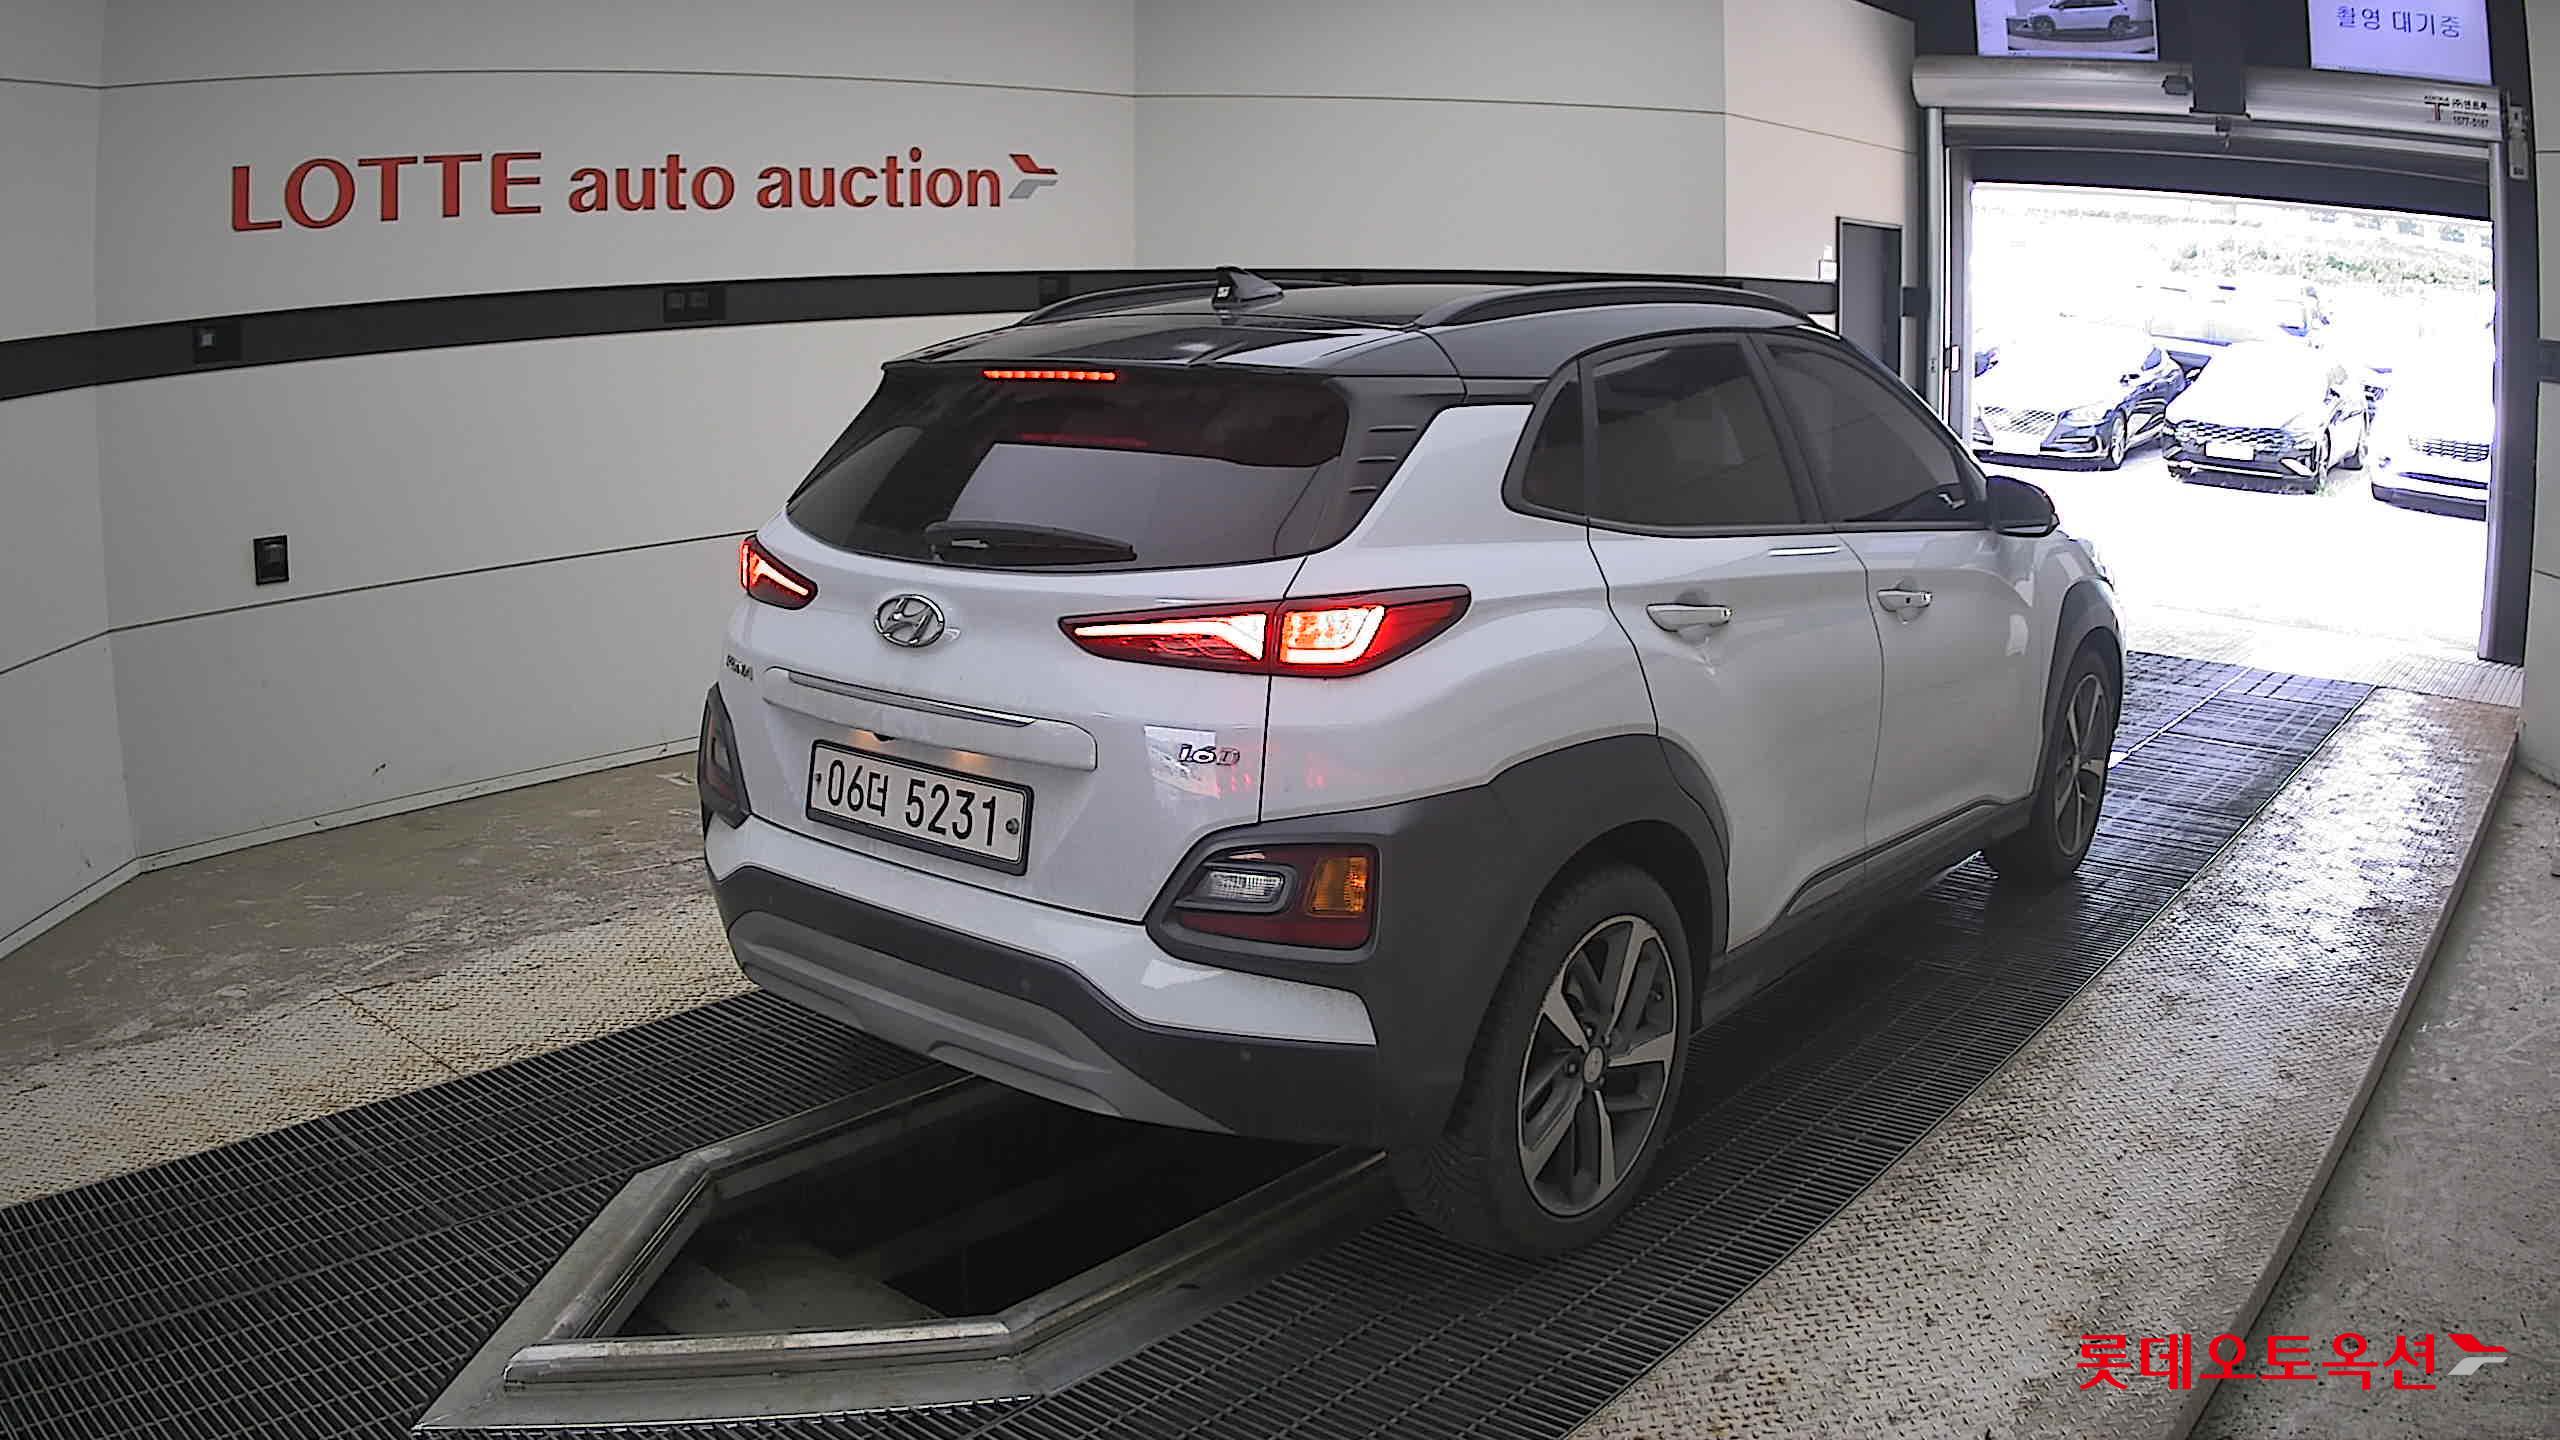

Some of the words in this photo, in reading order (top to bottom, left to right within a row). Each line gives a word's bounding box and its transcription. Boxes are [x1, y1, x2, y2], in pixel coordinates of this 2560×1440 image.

[2337, 6, 2381, 31] 촬영
[2392, 11, 2460, 38] 대기중
[232, 151, 542, 232] LOTTE
[567, 153, 735, 214] auto
[755, 146, 1001, 209] auction
[827, 759, 889, 817] 06더
[905, 778, 996, 847] 5231
